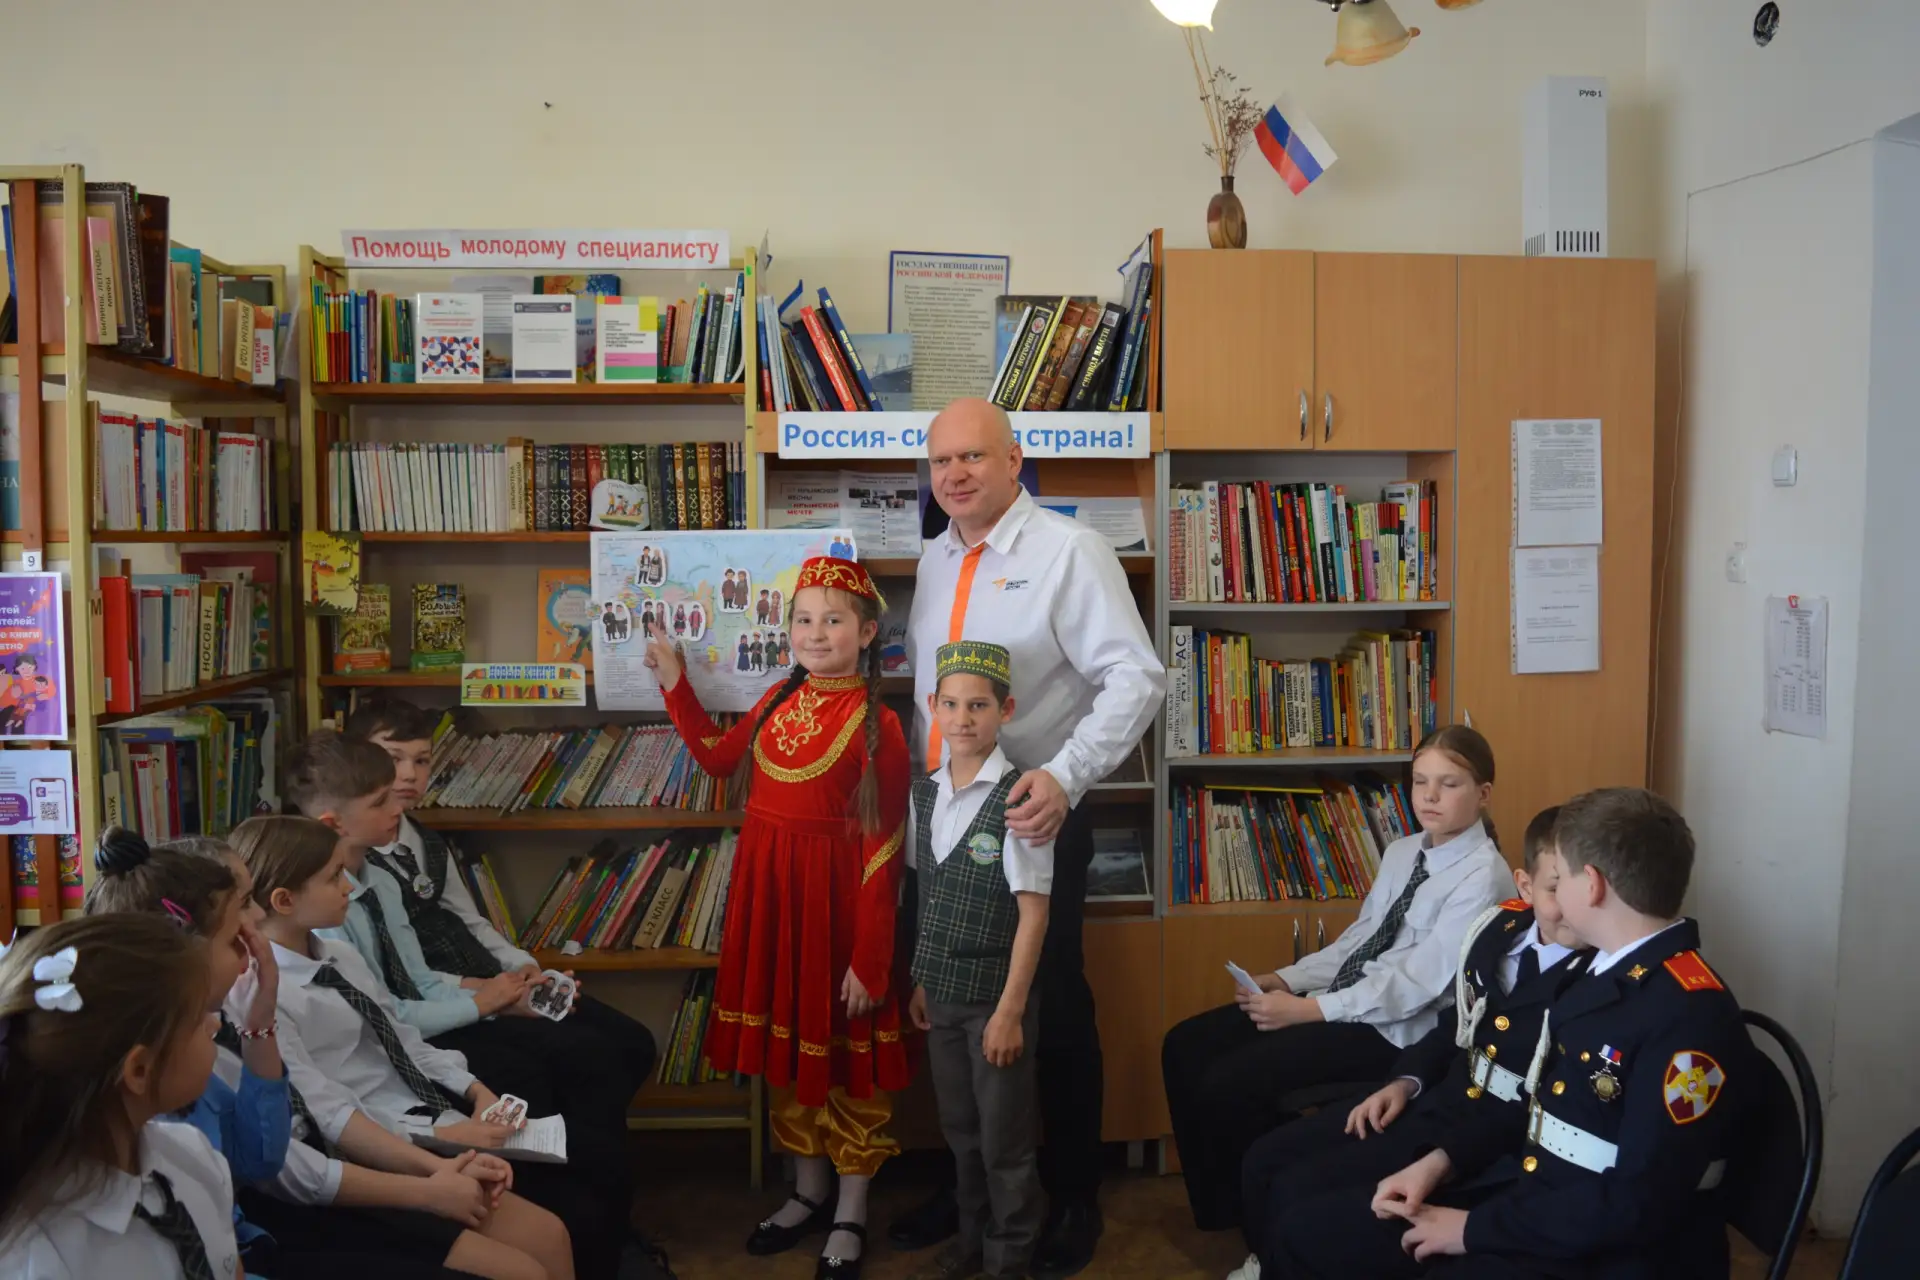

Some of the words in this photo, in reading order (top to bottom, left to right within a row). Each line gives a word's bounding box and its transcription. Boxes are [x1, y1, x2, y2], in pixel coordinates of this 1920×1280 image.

[352, 236, 451, 261] Помощь
[461, 237, 567, 260] молодому
[577, 238, 720, 264] специалисту
[896, 260, 979, 271] ГОСУДАРСТВЕННЫЙ
[896, 270, 952, 279] РОССИЙСКОЙ
[955, 272, 1003, 281] ФЕДЕРАЦИИ
[1026, 424, 1133, 453] страна!
[28, 555, 35, 567] 9
[202, 622, 213, 672] НОСОВ
[489, 667, 524, 681] НОВЫЕ
[526, 666, 559, 681] КНИГИ
[1167, 693, 1175, 731] ДЕТСКАЯ
[644, 921, 656, 936] 1-2
[653, 887, 674, 920] КЛАСС
